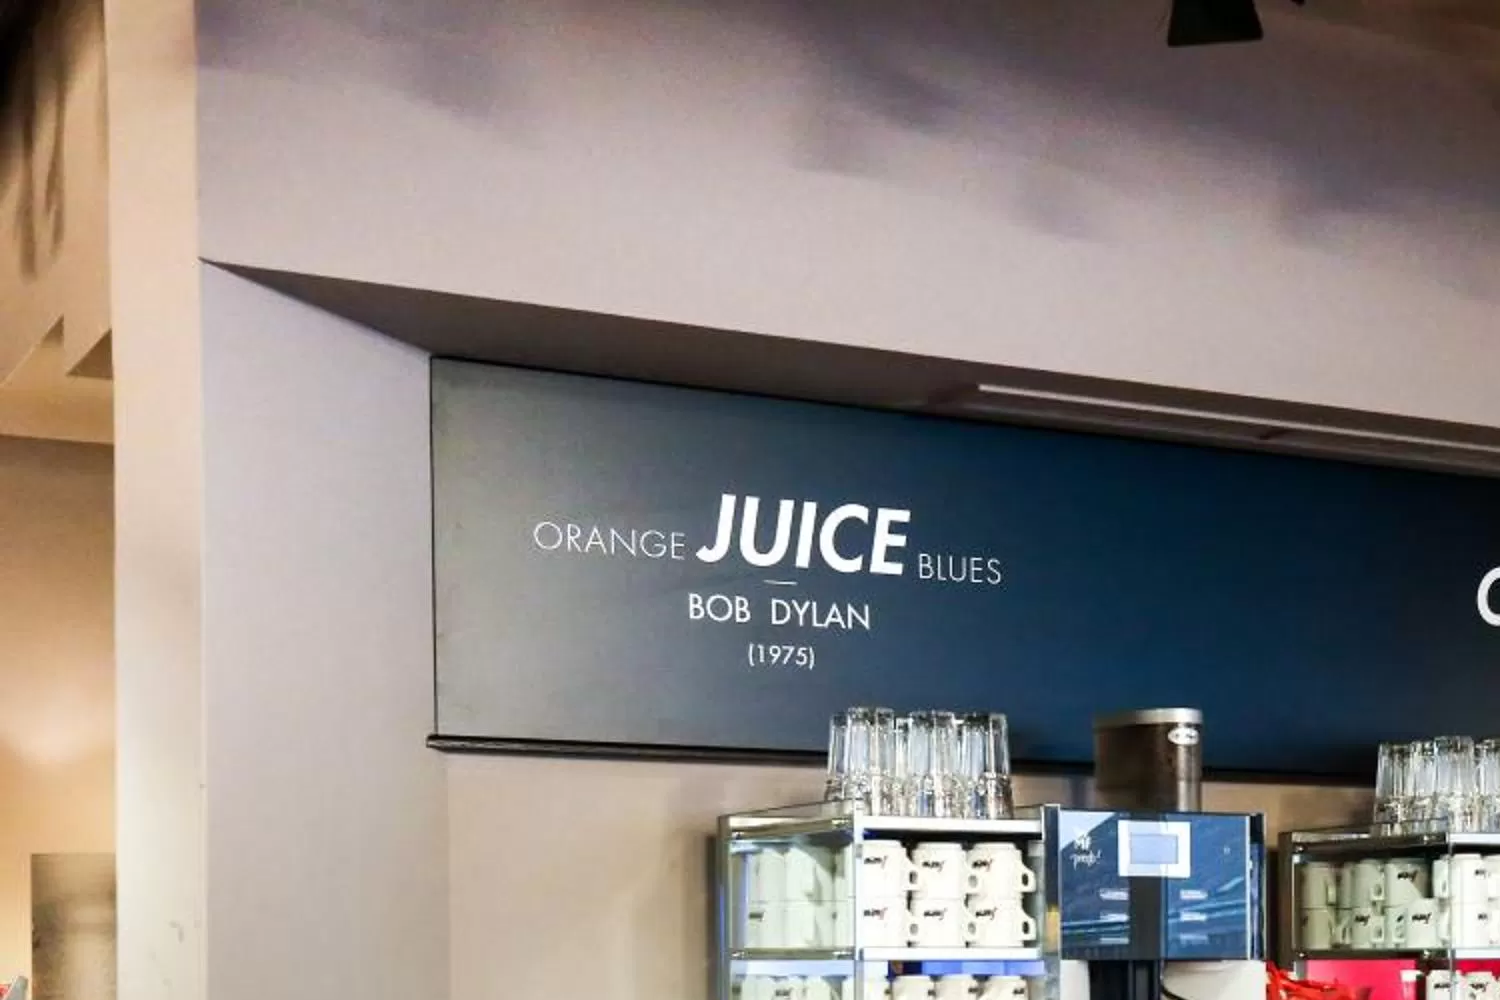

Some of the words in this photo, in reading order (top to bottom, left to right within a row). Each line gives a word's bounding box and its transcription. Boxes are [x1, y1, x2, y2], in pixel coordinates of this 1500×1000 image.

[533, 521, 686, 560] ORANGE
[696, 493, 912, 576] JUICE
[918, 553, 1002, 585] BLUES
[688, 594, 751, 623] BOB
[770, 598, 871, 631] DYLAN
[747, 644, 816, 670] (1975)
